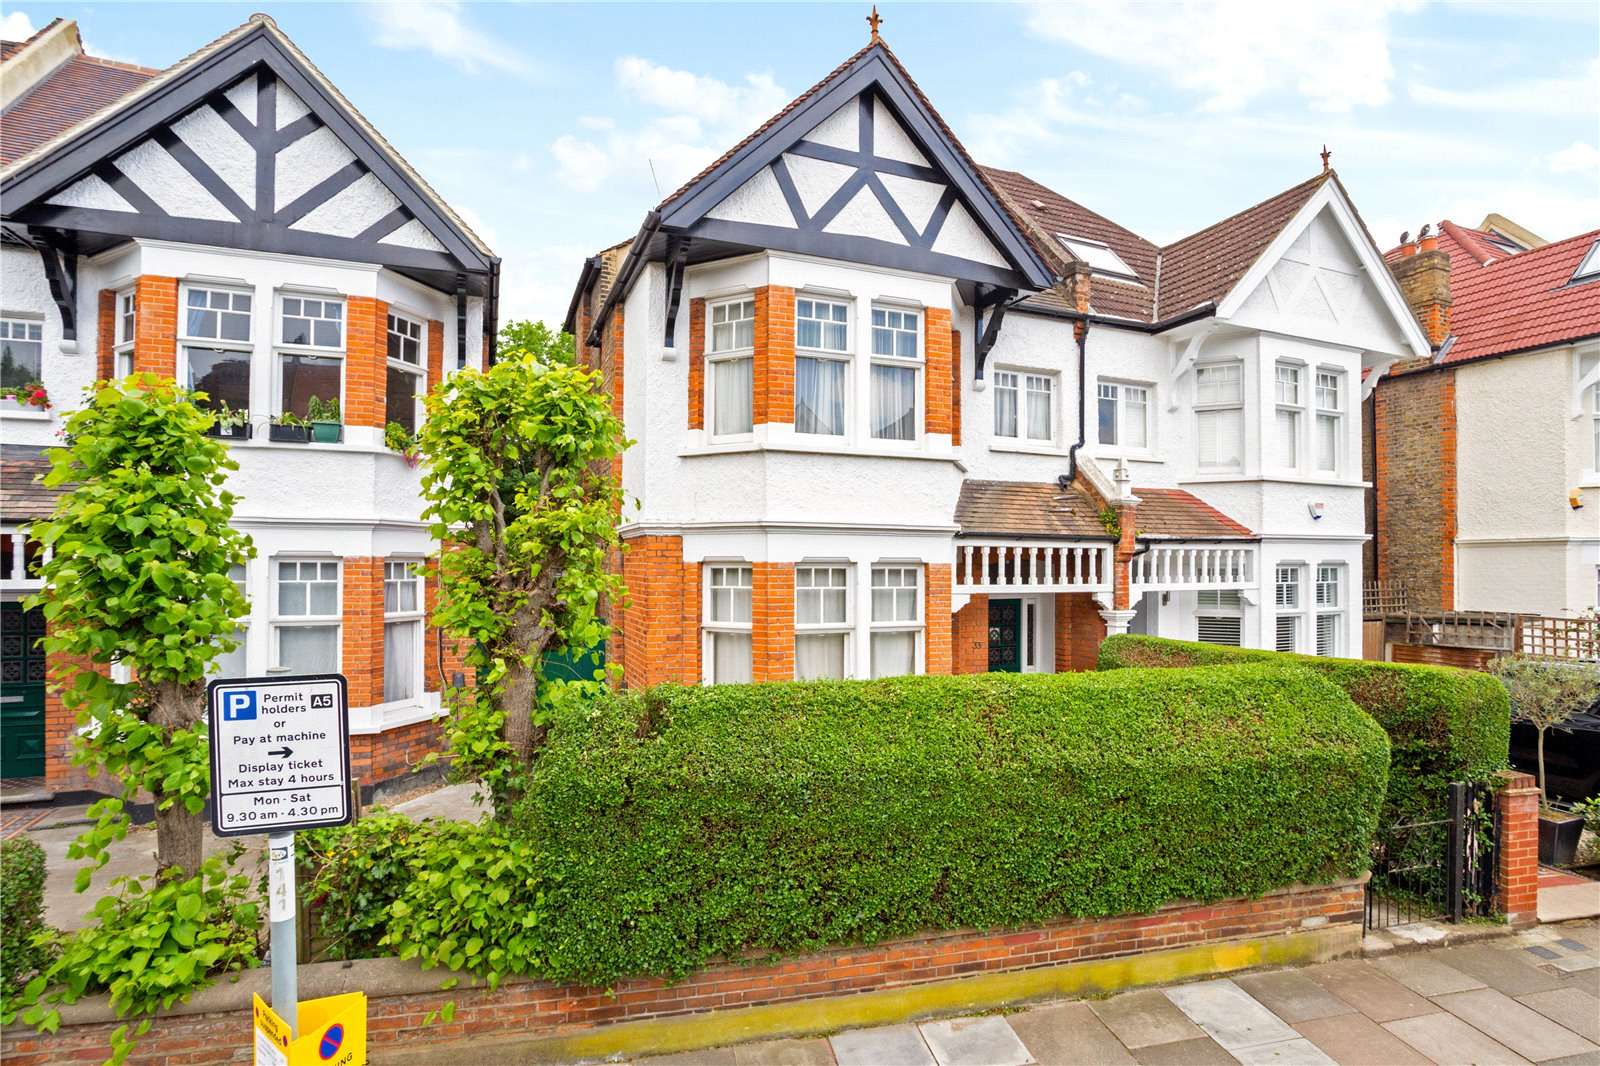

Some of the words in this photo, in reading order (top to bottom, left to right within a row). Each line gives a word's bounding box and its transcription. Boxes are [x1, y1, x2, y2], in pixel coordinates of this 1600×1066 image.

[263, 693, 304, 702] Permit
[312, 697, 332, 707] A5
[230, 694, 250, 718] P
[262, 705, 306, 714] holders
[274, 720, 286, 728] or
[234, 736, 255, 746] Pay
[260, 734, 272, 744] at
[276, 732, 326, 742] machine
[238, 762, 284, 773] Display
[288, 760, 323, 770] ticket
[228, 779, 254, 788] Max
[258, 776, 284, 787] stay
[288, 775, 296, 784] 4
[301, 774, 334, 783] hours
[254, 796, 280, 806] Mon
[290, 794, 311, 803] Sat
[226, 812, 256, 823] 9.30
[288, 807, 318, 818] 4.30
[320, 806, 338, 815] pm
